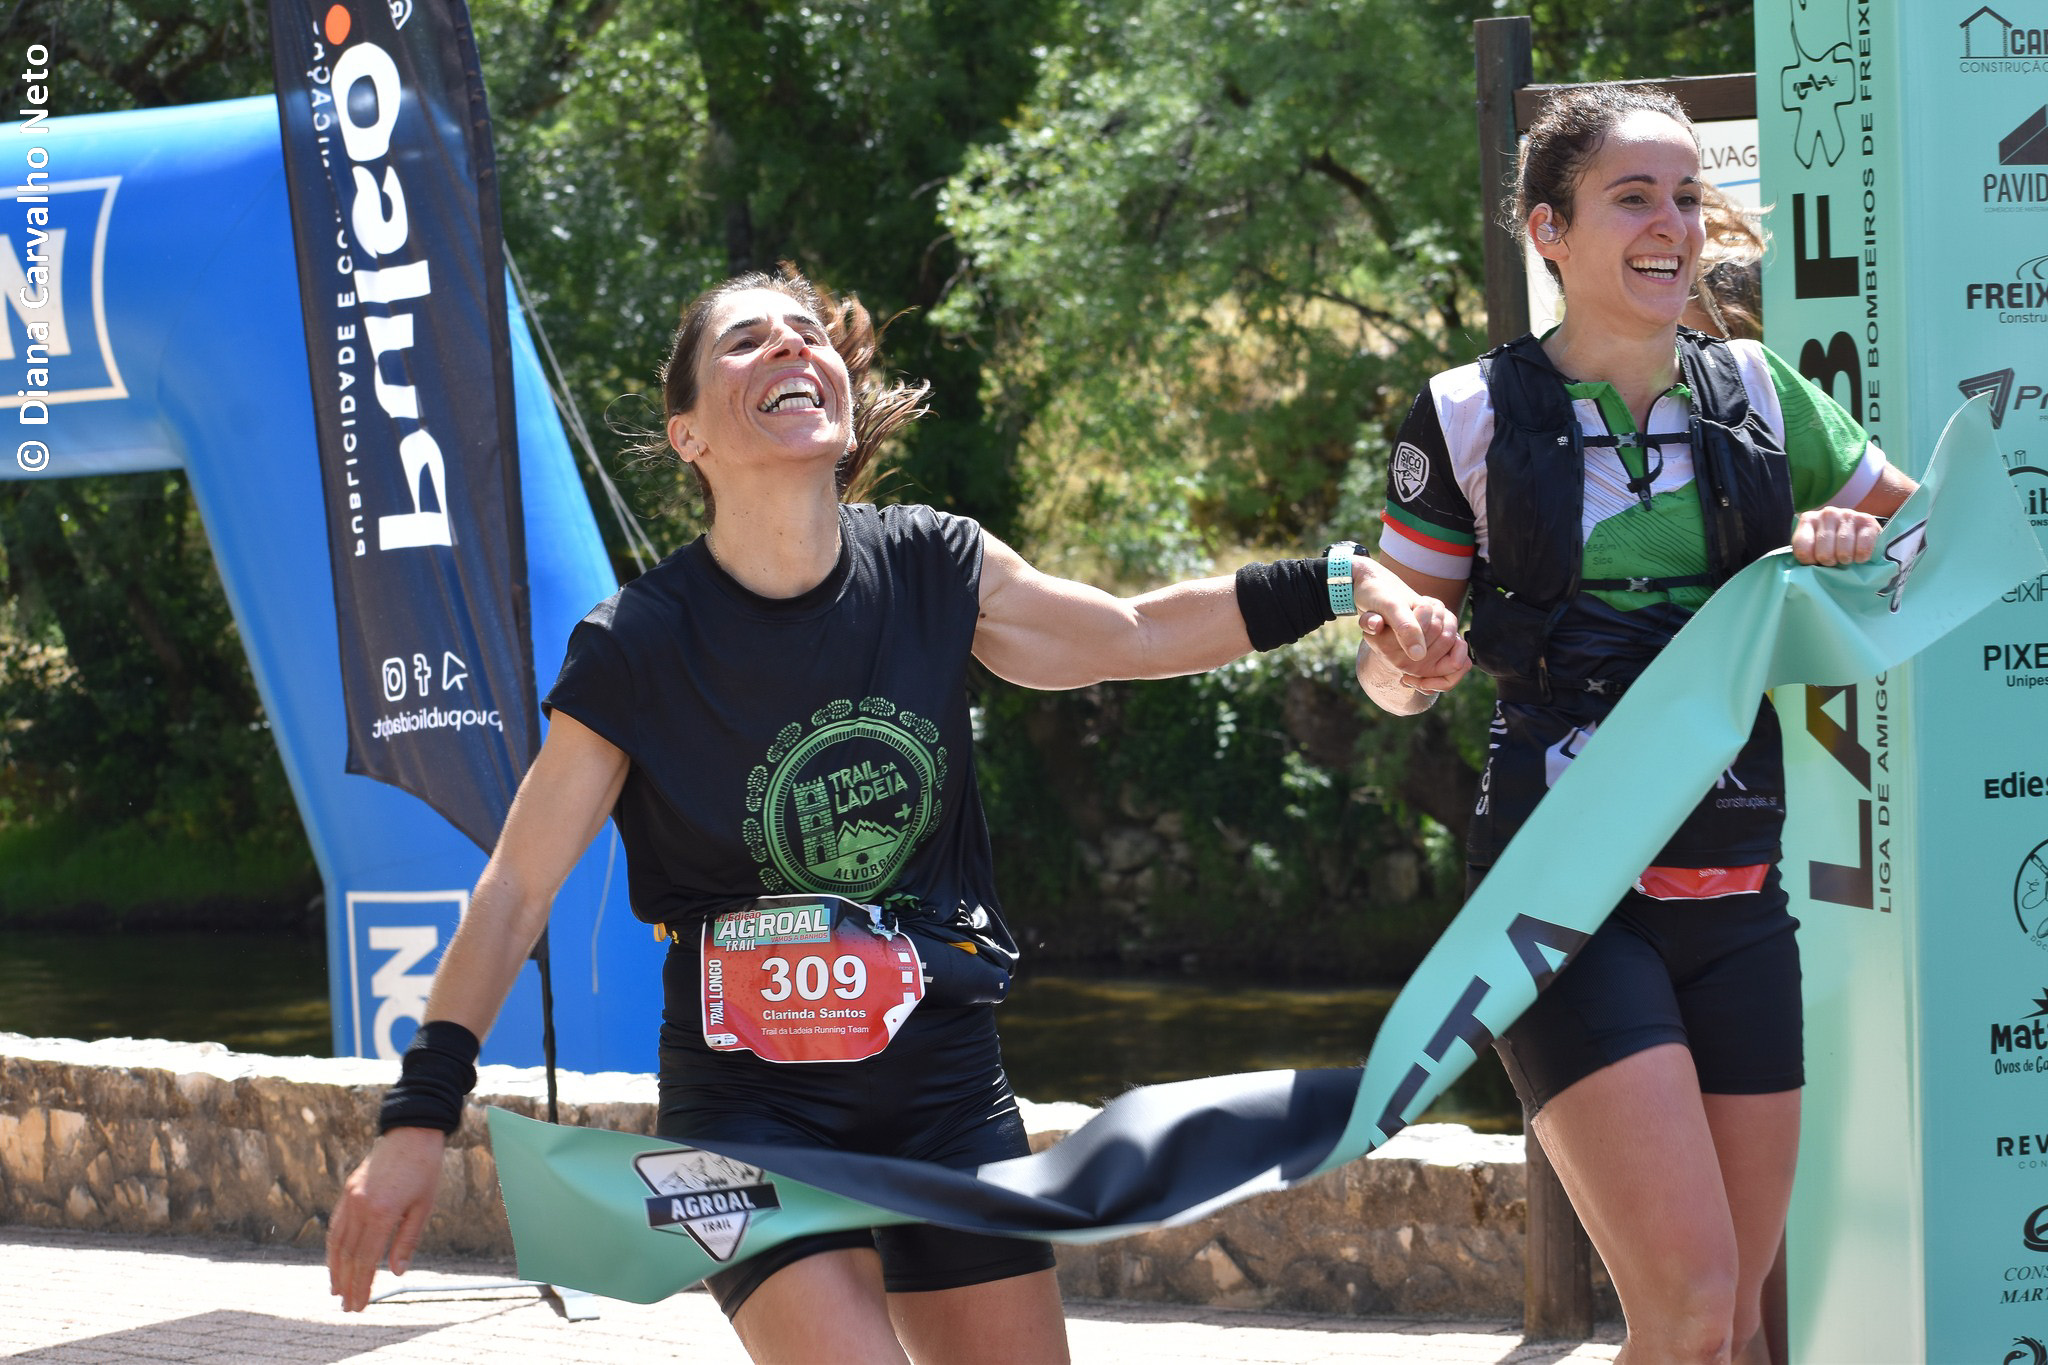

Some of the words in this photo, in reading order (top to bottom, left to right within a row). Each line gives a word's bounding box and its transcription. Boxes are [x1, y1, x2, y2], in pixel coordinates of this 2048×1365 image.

[1860, 113, 1873, 156] DE
[1862, 167, 1879, 367] BOMBEIROS
[1868, 380, 1880, 422] DE
[828, 761, 880, 792] TRAIL
[881, 762, 897, 774] DA
[835, 772, 908, 814] LADEIA
[1878, 783, 1890, 826] DE
[1878, 838, 1891, 913] LIGA
[717, 909, 829, 940] AGROAL
[728, 910, 763, 922] Edição
[725, 939, 757, 952] TRAIL
[708, 958, 723, 1000] LONGO
[760, 955, 868, 1001] 309
[710, 1000, 724, 1027] TRAIL
[762, 1009, 815, 1020] Clarinda
[819, 1008, 867, 1019] Santos
[814, 1026, 846, 1034] Running
[1991, 1019, 2048, 1054] Mat
[1995, 1058, 2020, 1075] Ovos
[2023, 1059, 2033, 1071] de
[671, 1190, 756, 1221] AGROAL
[701, 1219, 733, 1233] TRAIL
